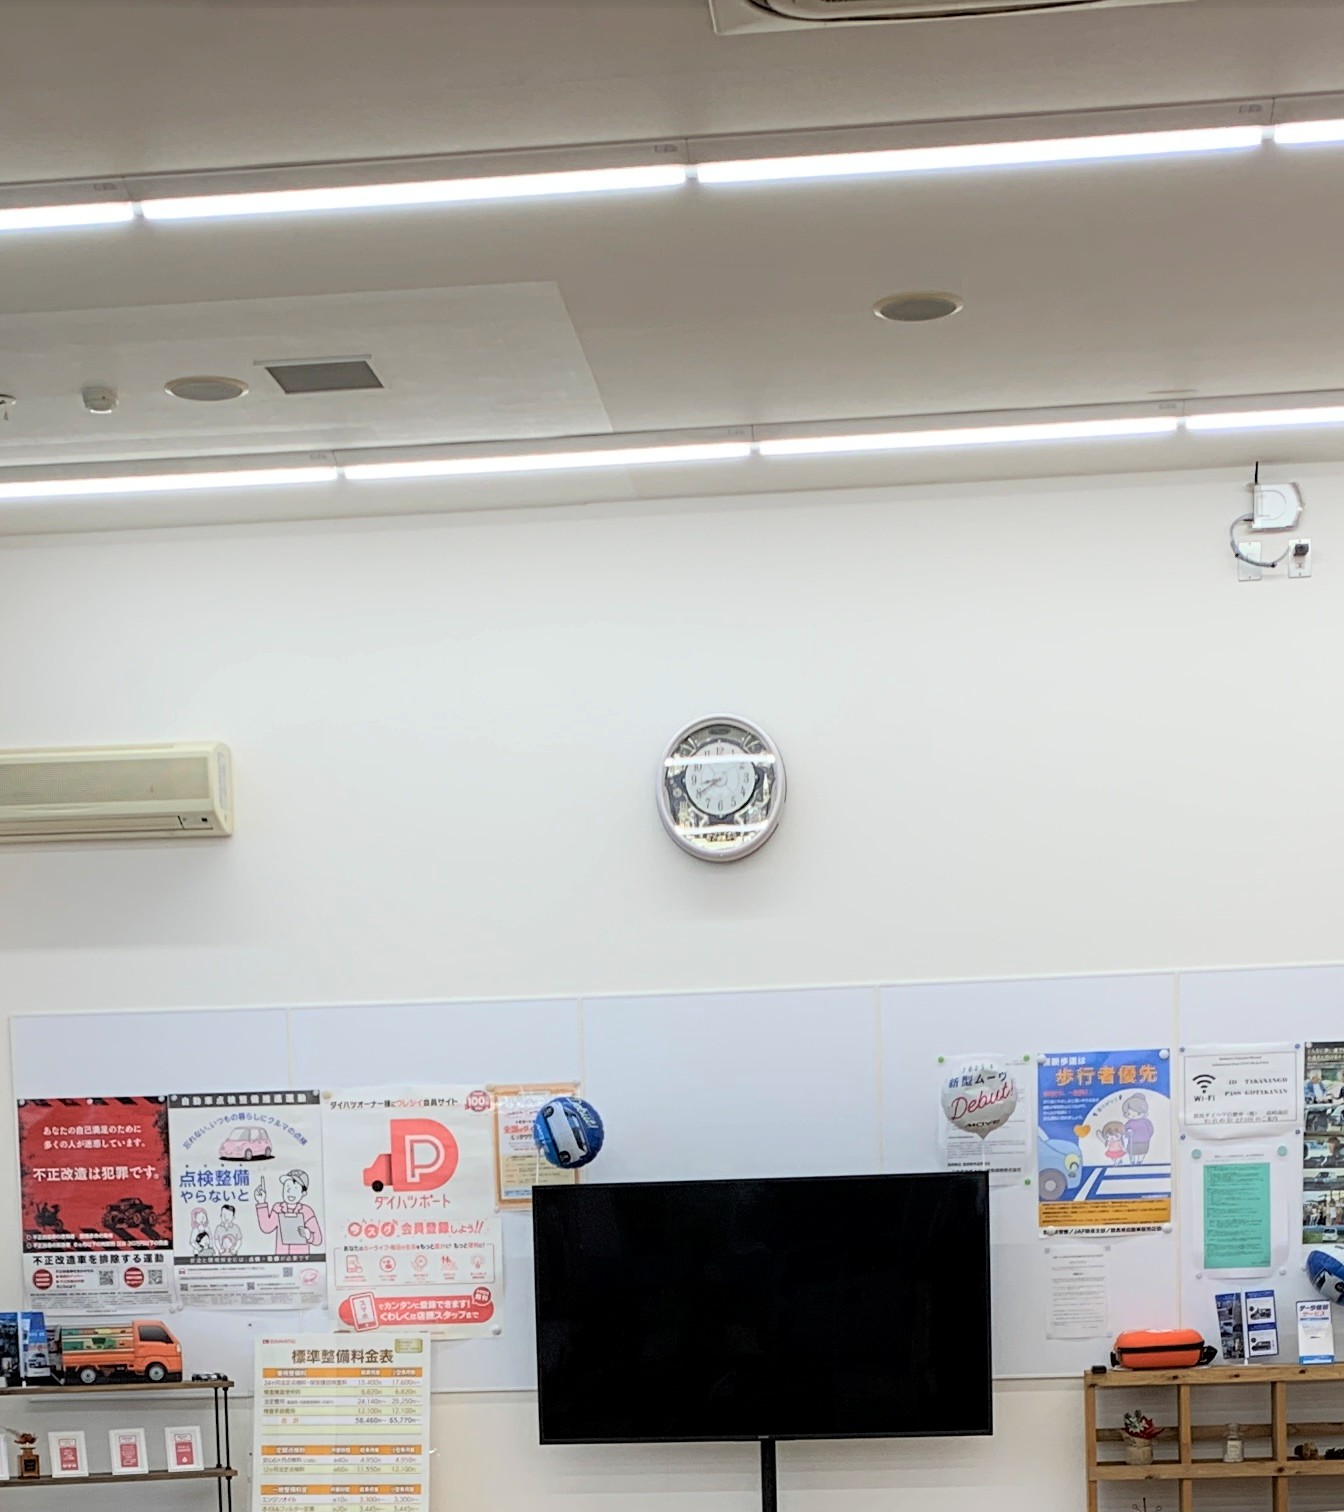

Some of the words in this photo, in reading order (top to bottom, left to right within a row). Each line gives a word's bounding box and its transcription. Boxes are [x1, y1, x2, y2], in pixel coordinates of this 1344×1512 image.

[1056, 1063, 1158, 1087] 歩行者優先
[951, 1078, 1014, 1121] Debut!
[33, 1165, 160, 1182] 不正改造は犯罪です。
[179, 1169, 250, 1188] 点検整備
[180, 1189, 249, 1204] やらないと
[374, 1194, 451, 1210] ダイハツポート
[292, 1349, 394, 1364] 標準整備料金表
